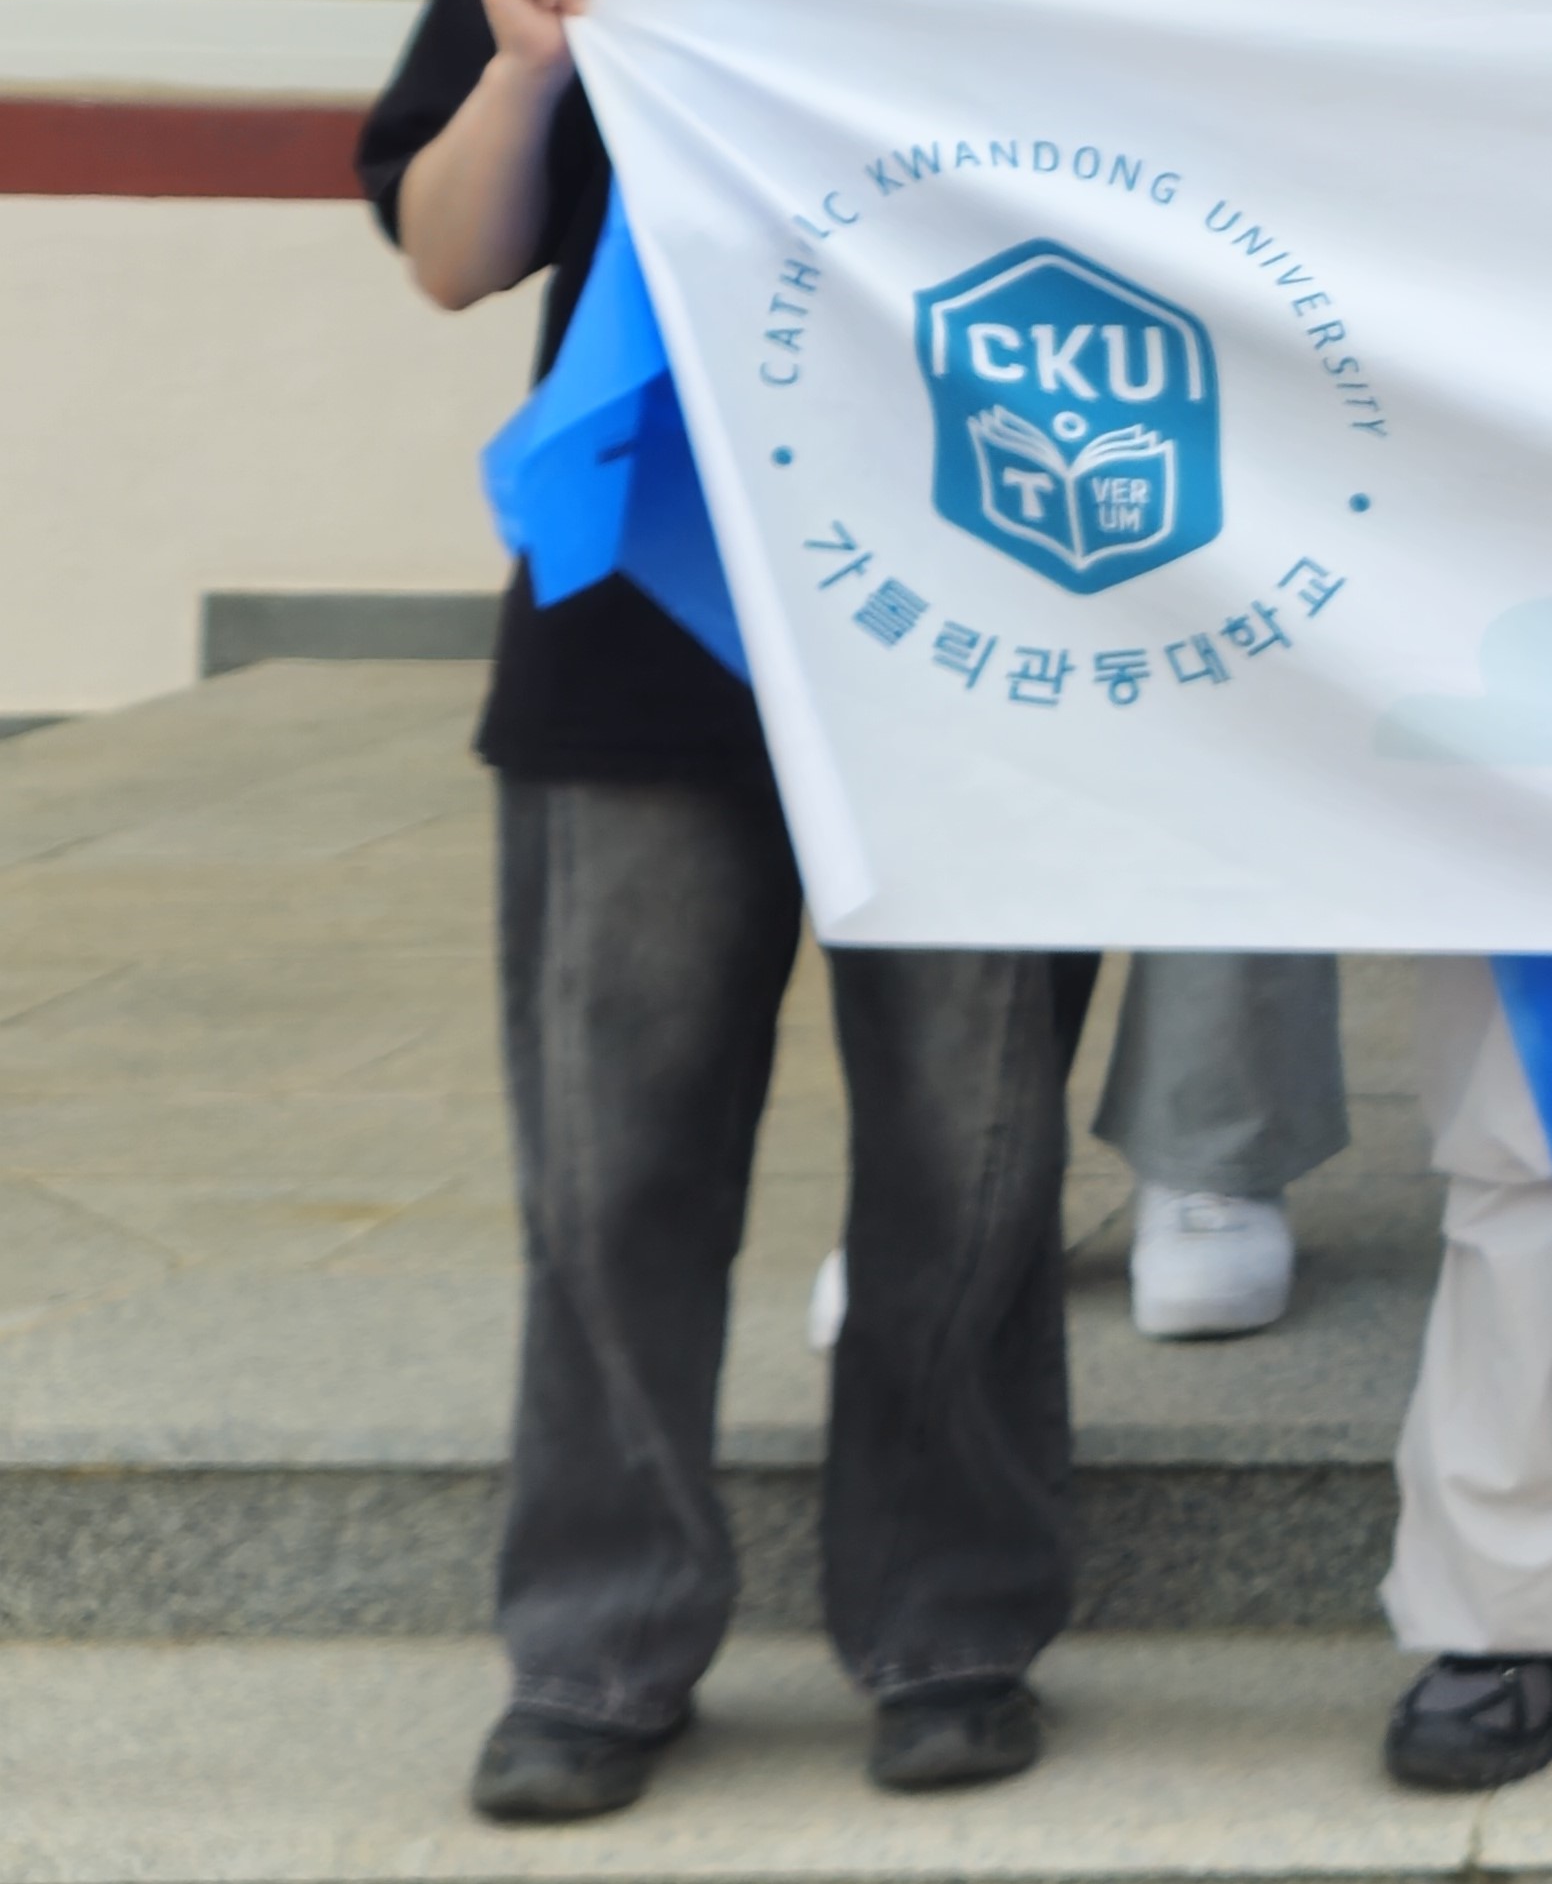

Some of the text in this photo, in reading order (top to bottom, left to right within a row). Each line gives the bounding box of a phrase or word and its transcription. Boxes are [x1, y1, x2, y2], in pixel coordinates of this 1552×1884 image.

[865, 139, 1184, 205] KWANDONG
[1204, 200, 1388, 439] UNIVERSITY
[967, 322, 1166, 403] CKU
[1002, 467, 1054, 519] T
[1092, 478, 1148, 504] VER
[803, 520, 1347, 708] 가톨릭관동대학교
